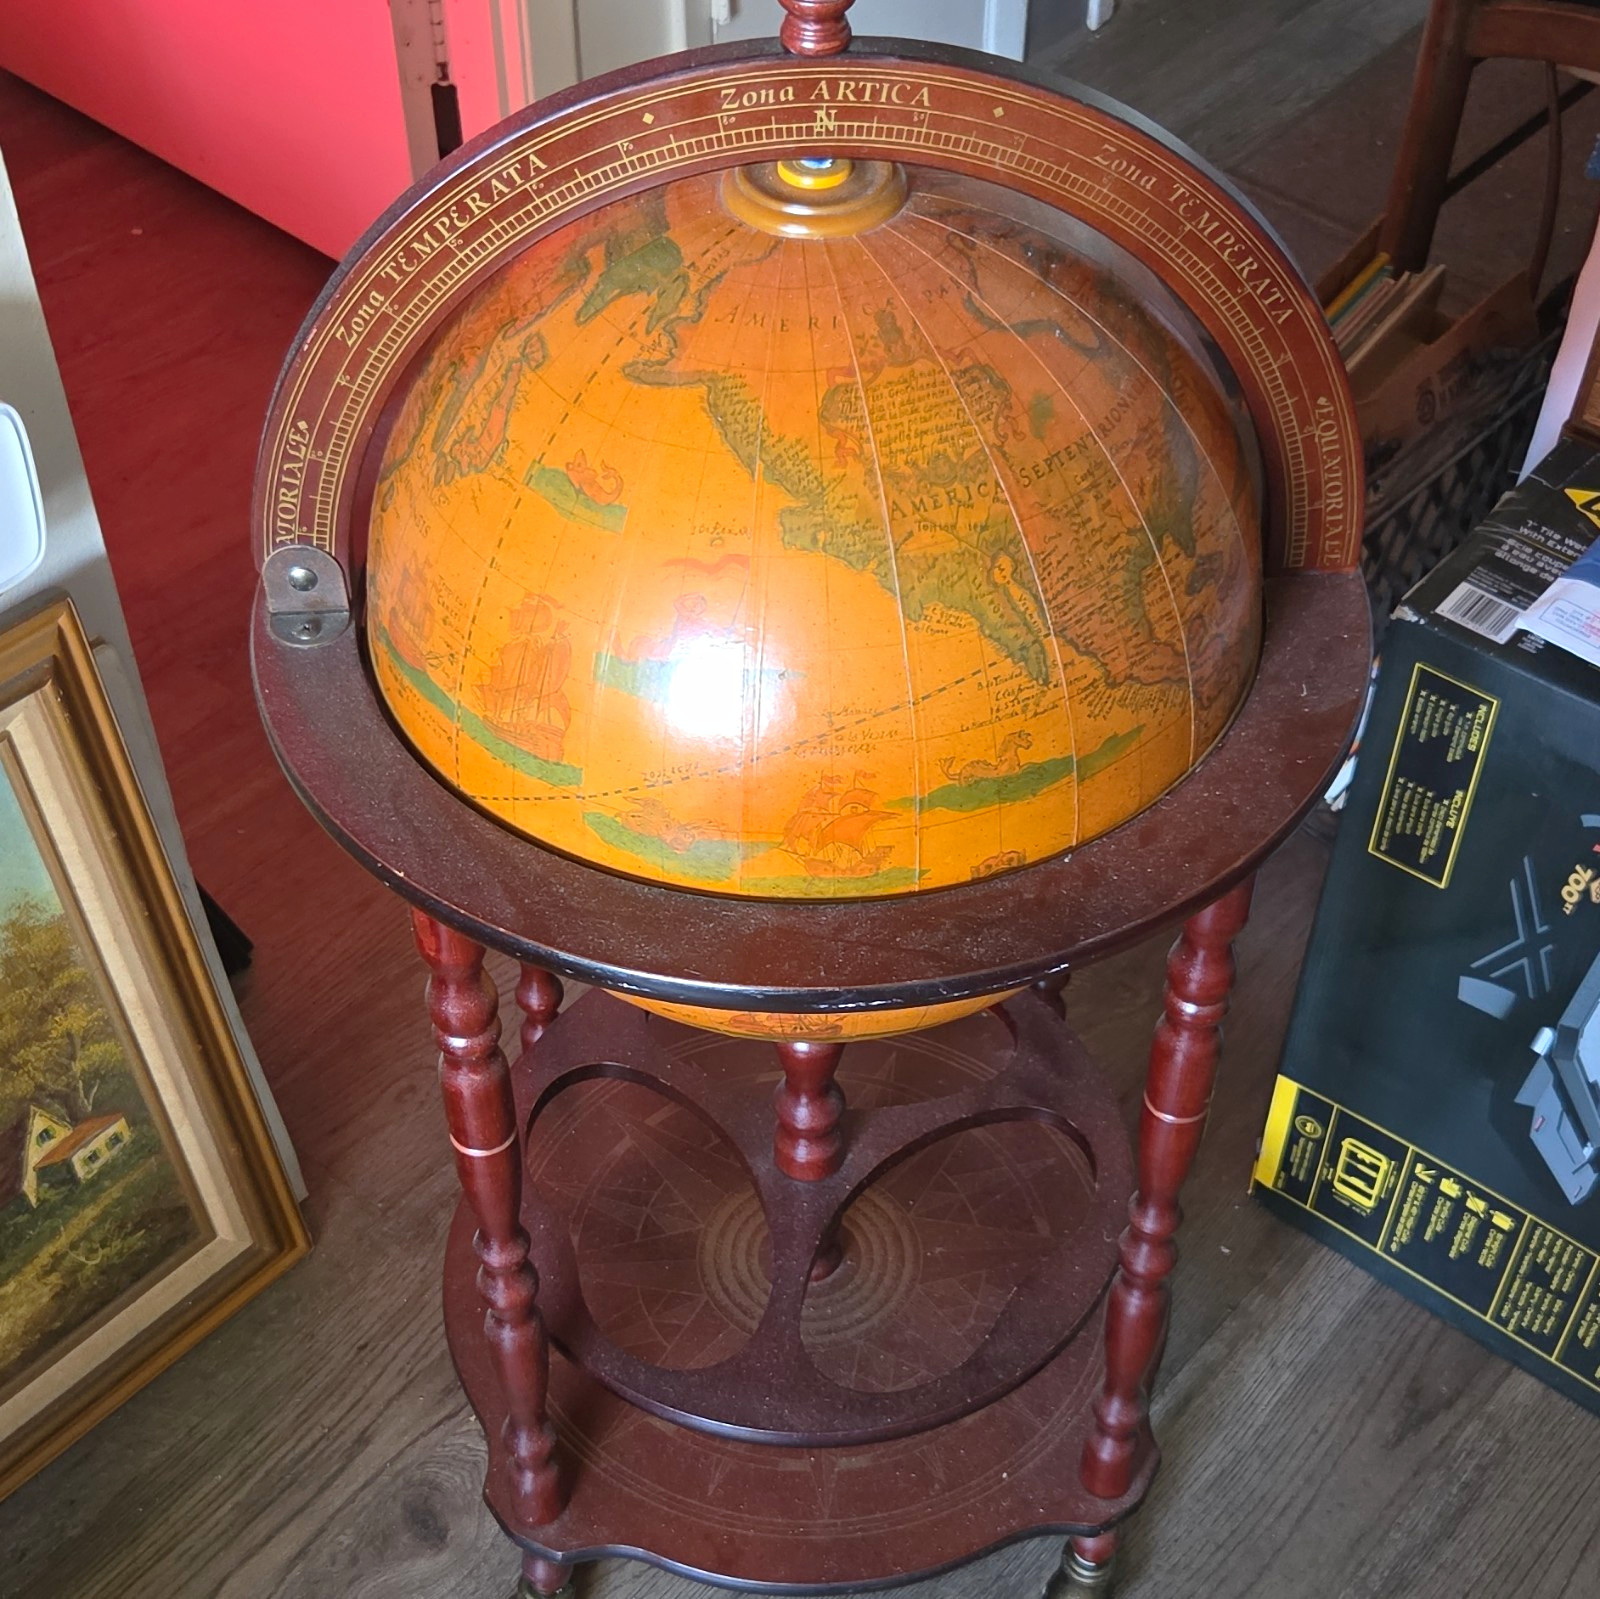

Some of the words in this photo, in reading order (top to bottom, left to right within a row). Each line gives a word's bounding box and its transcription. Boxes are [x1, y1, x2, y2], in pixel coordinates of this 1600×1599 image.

[720, 85, 796, 110] Zona
[811, 80, 931, 107] ARTICA
[813, 109, 838, 132] N
[336, 290, 386, 348] Zona
[380, 153, 549, 286] TEMPERATA
[1093, 144, 1157, 191] Zona
[1171, 182, 1296, 326] TEMPERATA
[276, 428, 310, 545] ATORIALE
[890, 478, 1006, 521] AMERICA
[1314, 404, 1344, 567] EQUATORIALE
[1507, 538, 1533, 554] Scie
[1519, 526, 1545, 543] With
[1540, 526, 1562, 541] Tile
[1564, 537, 1589, 552] Wet
[1468, 703, 1488, 752] INCLUDES
[1446, 789, 1464, 829] INCLUYE
